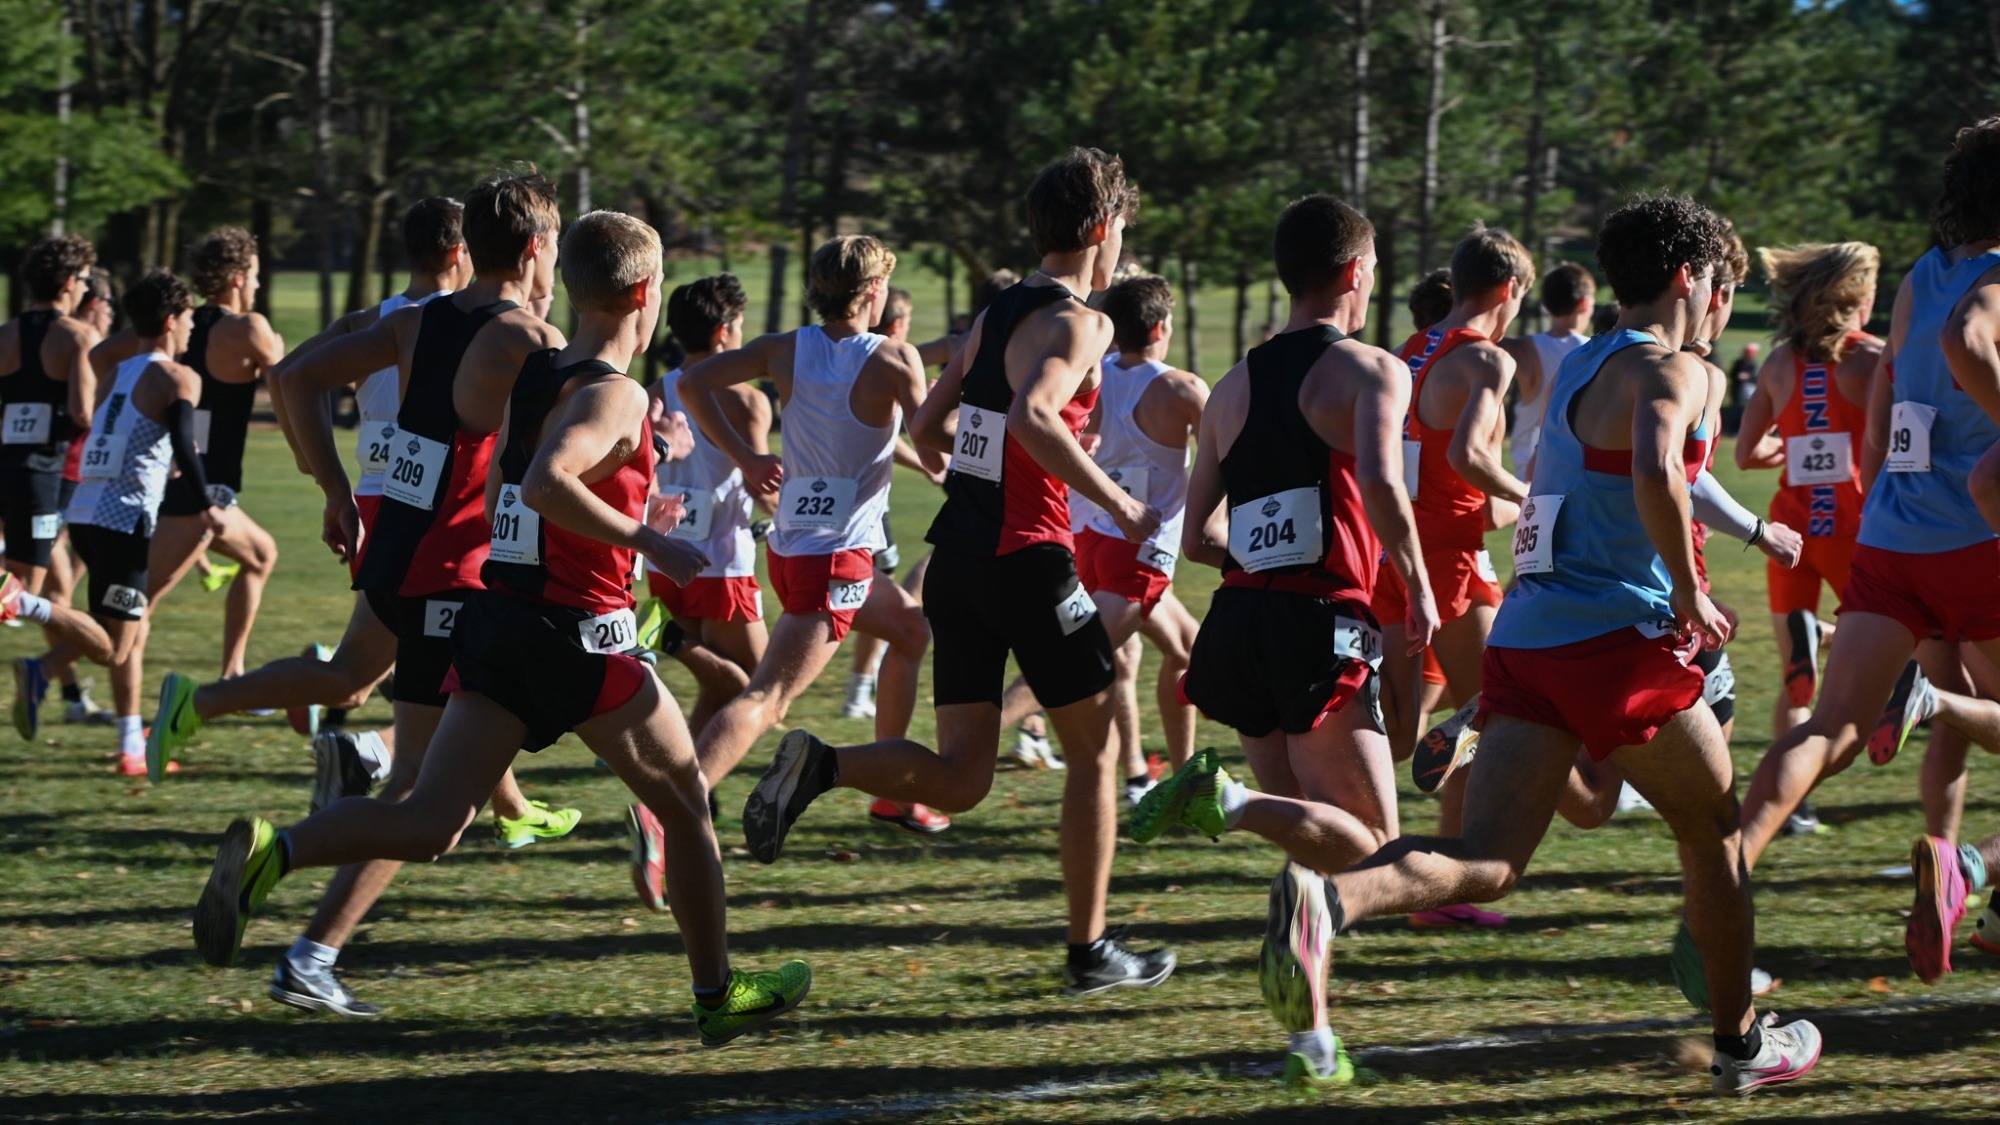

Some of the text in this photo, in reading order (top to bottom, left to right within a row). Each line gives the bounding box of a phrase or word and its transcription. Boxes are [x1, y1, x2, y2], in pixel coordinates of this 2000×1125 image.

[12, 418, 37, 433] 127
[369, 442, 390, 463] 24
[960, 431, 989, 459] 207
[86, 450, 110, 467] 531
[1802, 453, 1836, 471] 423
[391, 456, 424, 488] 209
[795, 496, 836, 516] 232
[492, 512, 520, 542] 201
[1248, 518, 1297, 552] 204
[1514, 524, 1540, 556] 295
[840, 584, 865, 604] 232
[595, 616, 633, 649] 201
